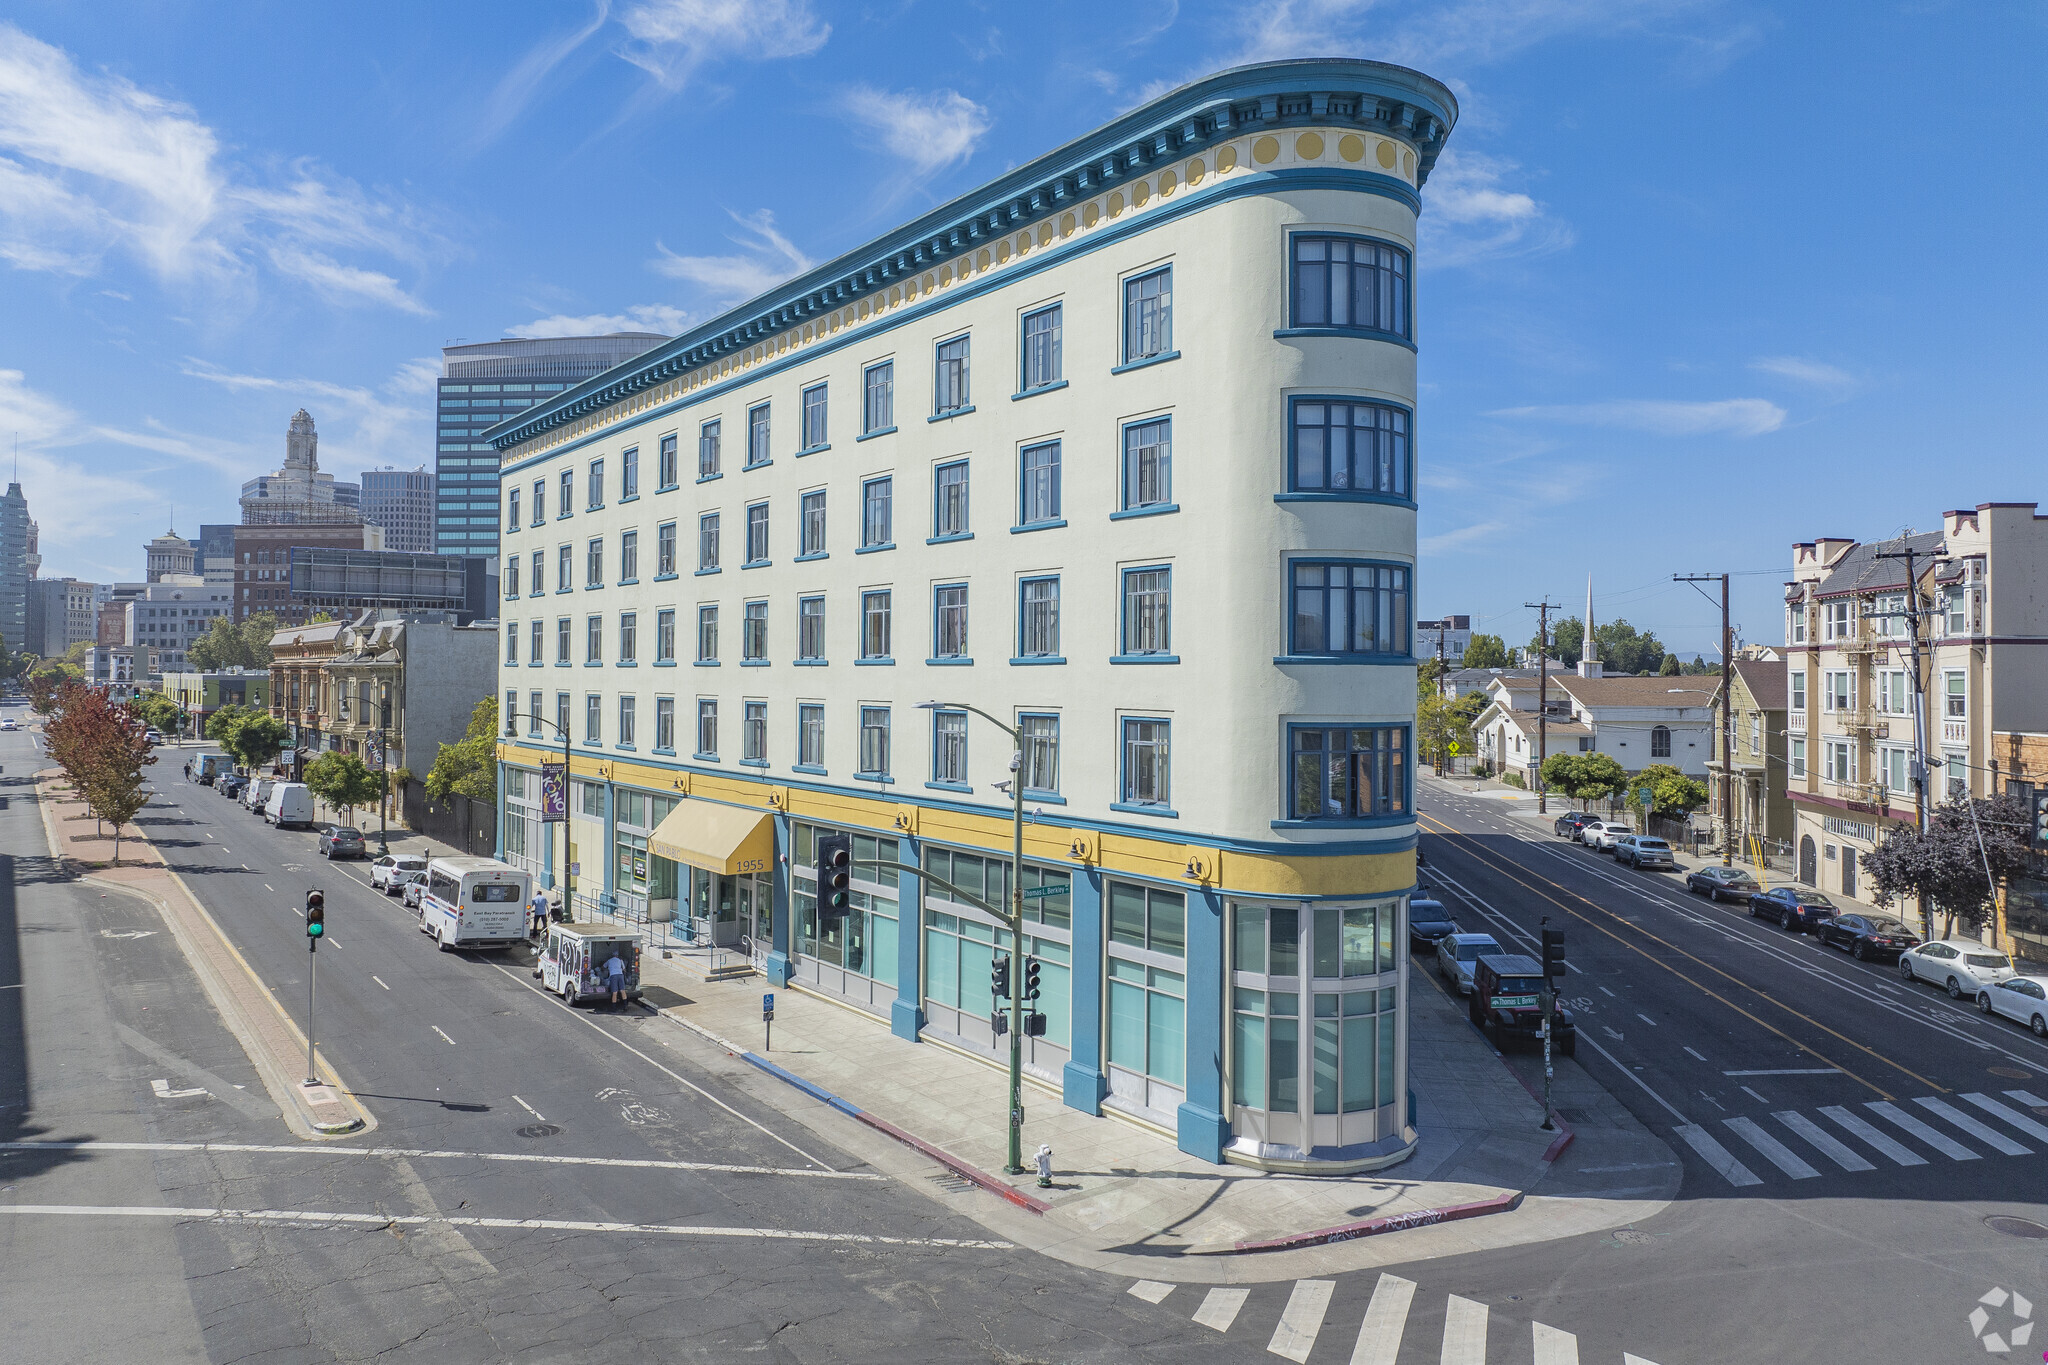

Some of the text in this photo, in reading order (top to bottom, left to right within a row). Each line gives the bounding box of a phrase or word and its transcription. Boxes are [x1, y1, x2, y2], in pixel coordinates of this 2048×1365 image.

[366, 739, 383, 763] KONO
[543, 776, 564, 811] KONO
[736, 859, 764, 873] 1955
[1024, 889, 1042, 897] Thomas
[1047, 886, 1065, 895] Berkley
[1522, 997, 1537, 1005] Berkley
